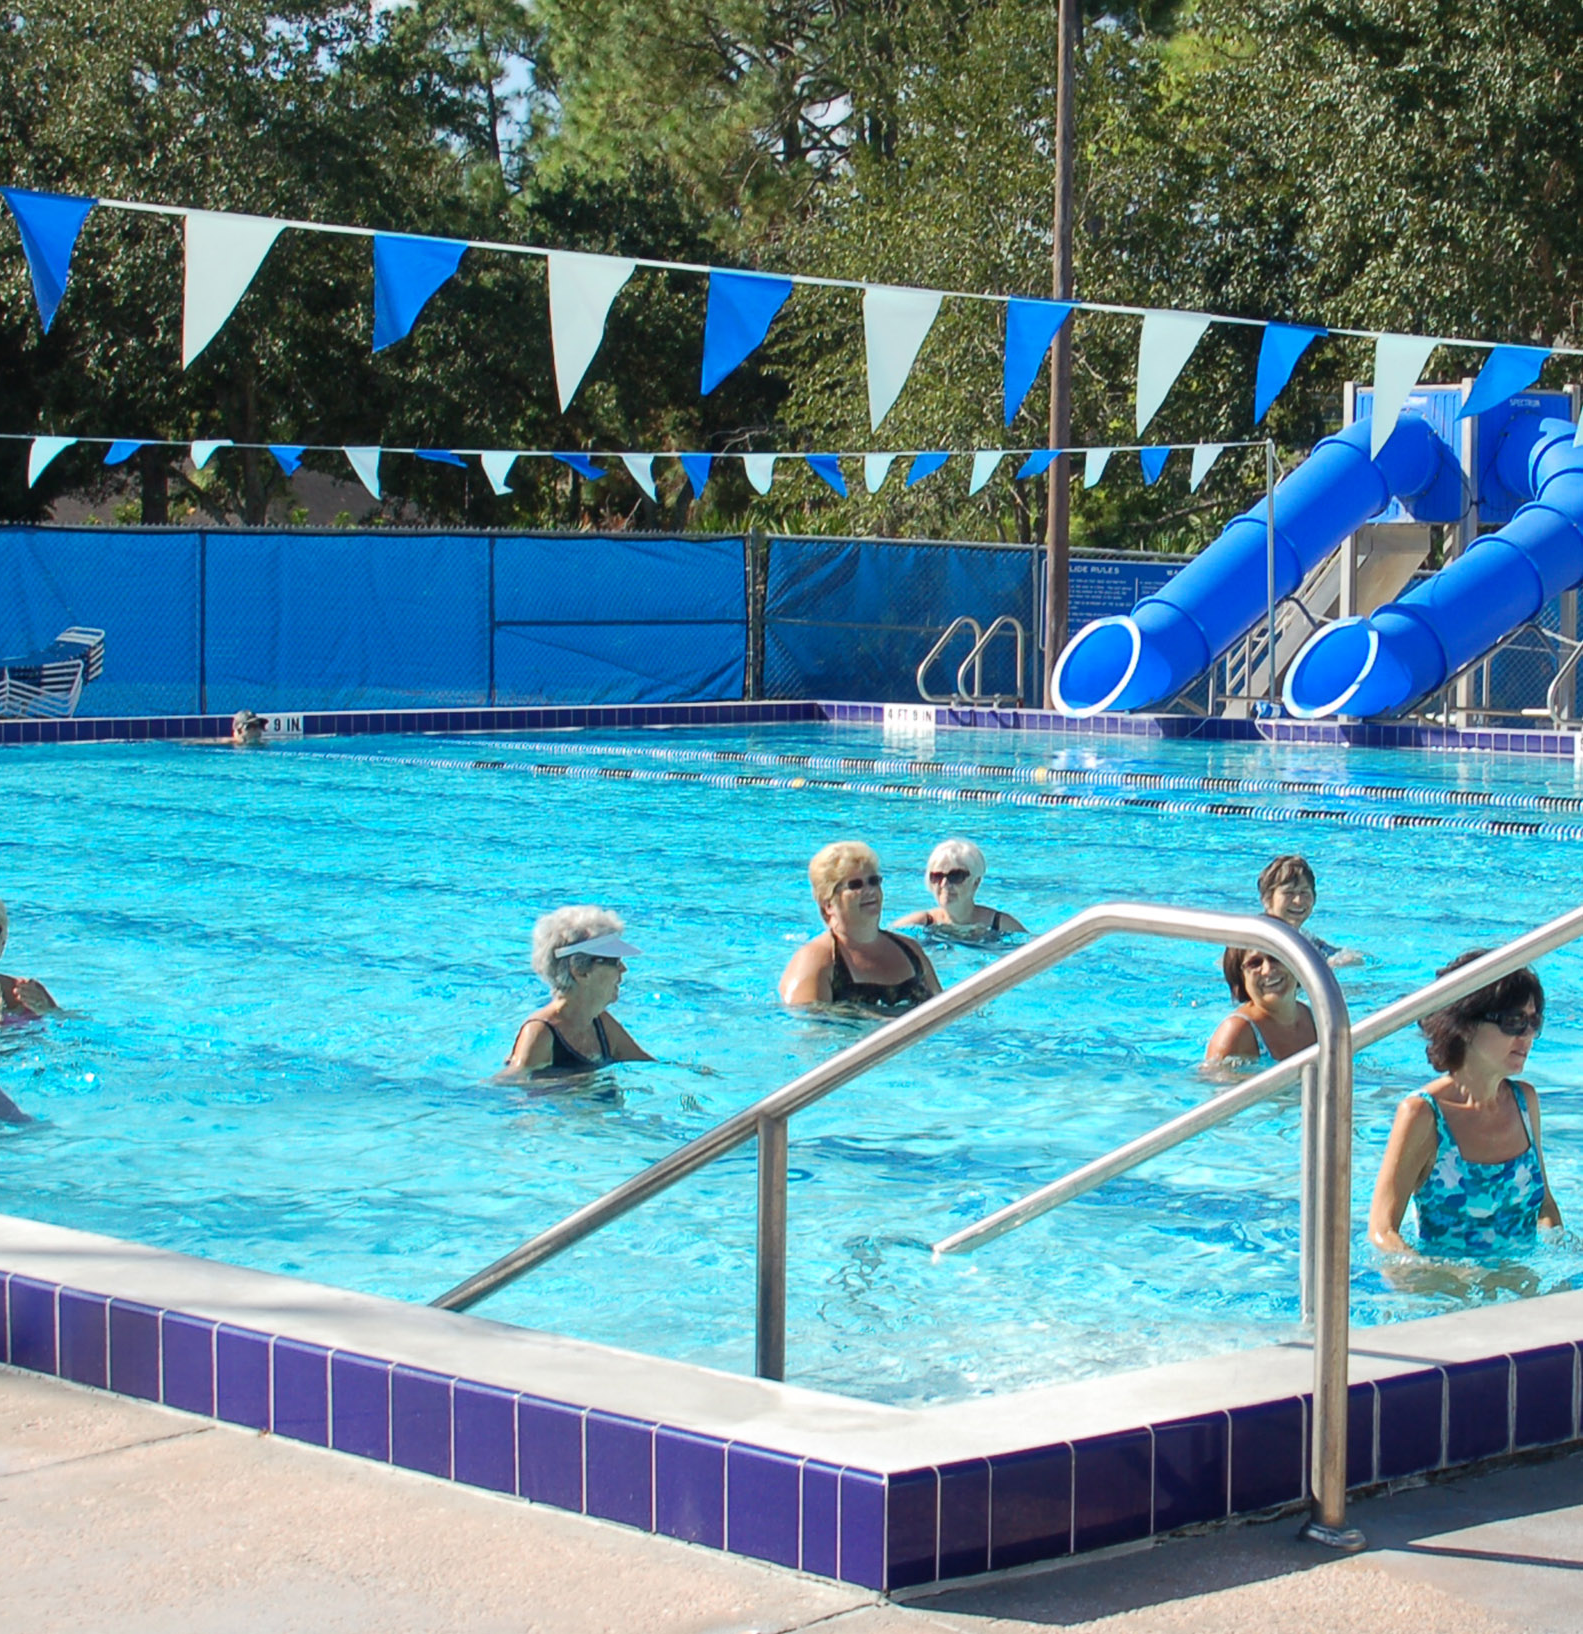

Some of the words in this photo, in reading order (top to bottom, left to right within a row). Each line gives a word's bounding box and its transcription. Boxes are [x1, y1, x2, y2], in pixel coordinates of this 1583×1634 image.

[1509, 398, 1541, 408] SPECTRUM
[1069, 565, 1088, 573] LIDE
[1090, 566, 1120, 575] RULES
[274, 718, 281, 732] 9
